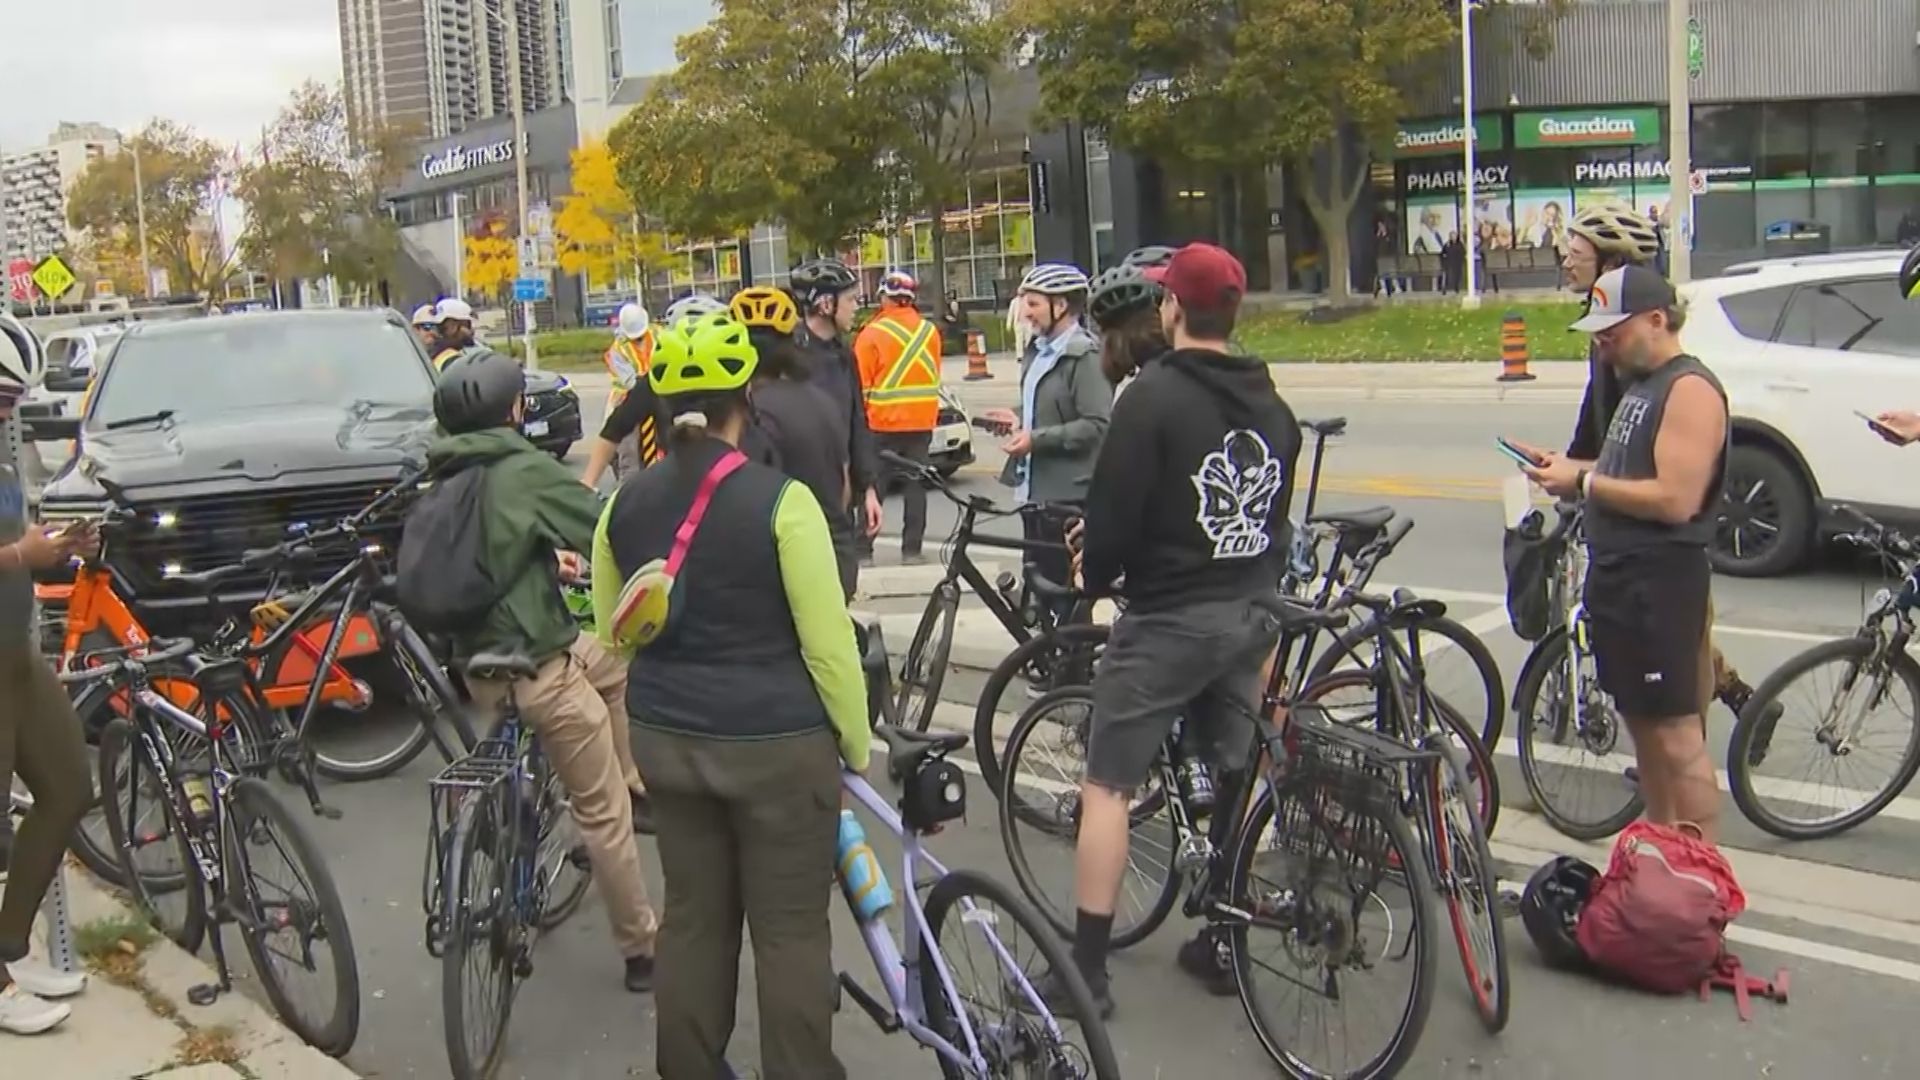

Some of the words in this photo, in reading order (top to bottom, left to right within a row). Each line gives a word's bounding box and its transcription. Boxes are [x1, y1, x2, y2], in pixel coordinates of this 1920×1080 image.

[1538, 116, 1635, 135] Guardian
[467, 140, 512, 168] FITNESS
[1575, 159, 1681, 180] PHARMA
